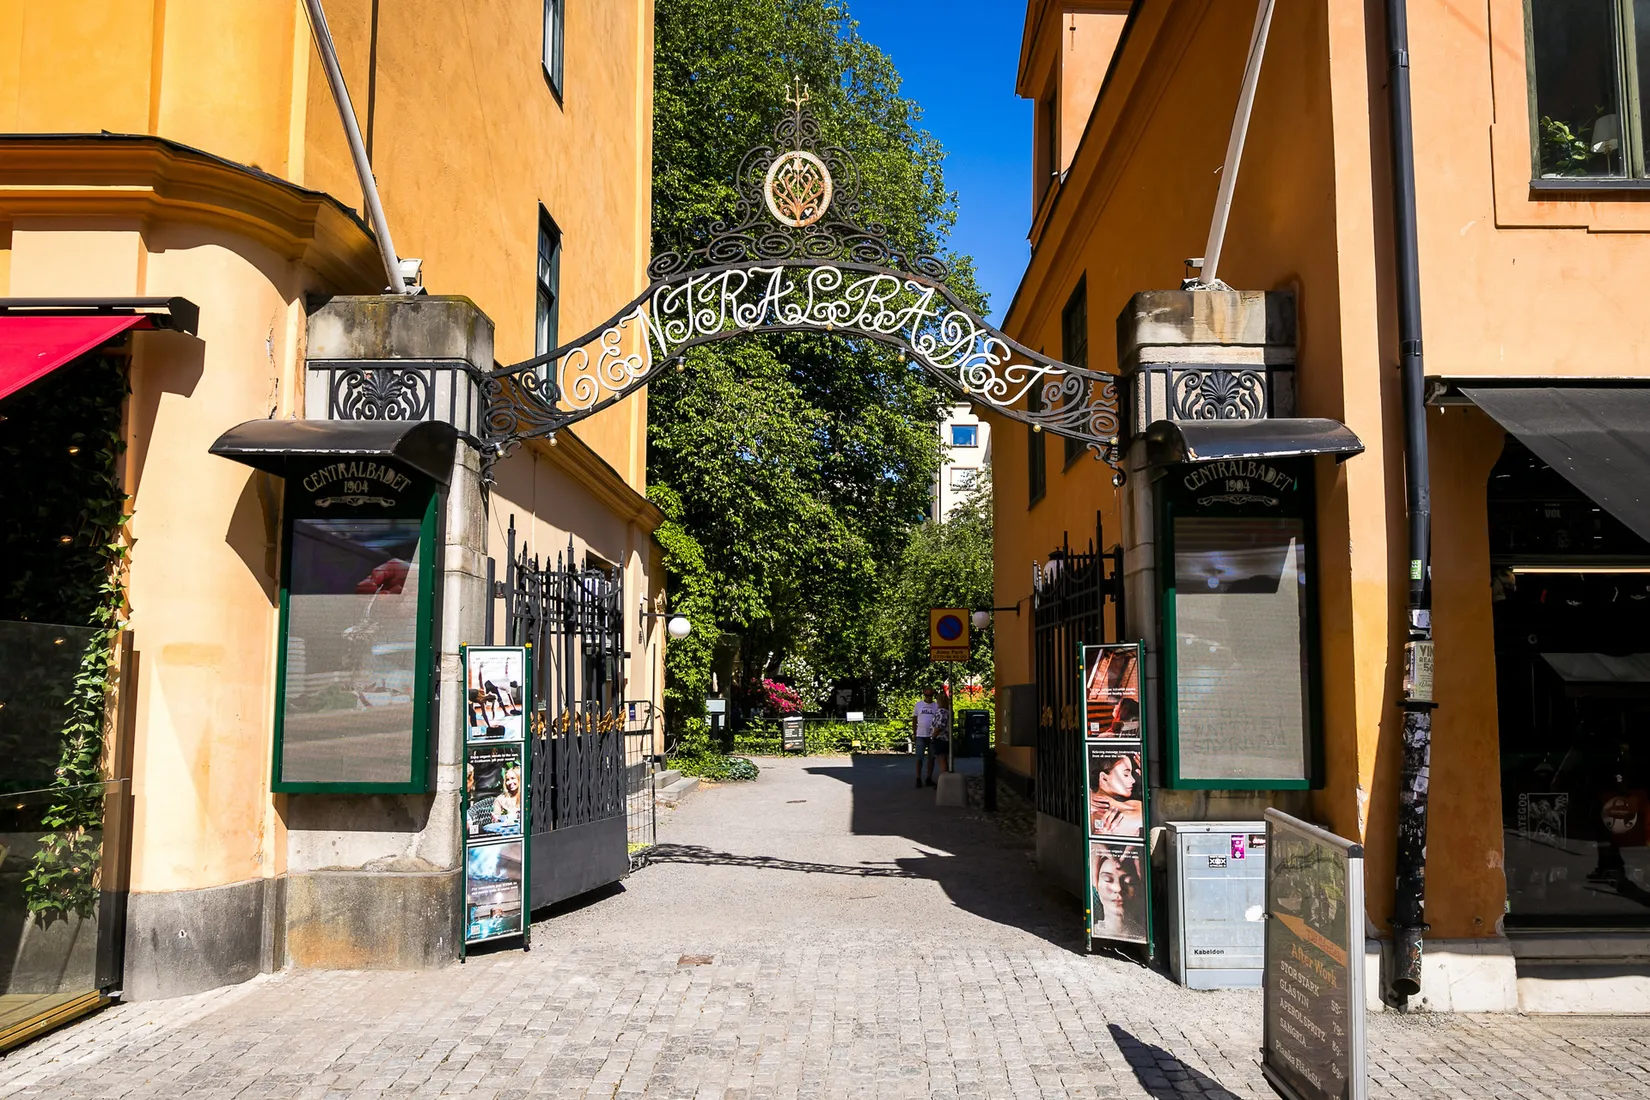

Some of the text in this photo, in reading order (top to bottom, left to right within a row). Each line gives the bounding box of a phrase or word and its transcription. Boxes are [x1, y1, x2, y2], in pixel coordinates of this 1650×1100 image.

[560, 265, 1067, 410] CENTRALBADET
[303, 461, 412, 492] CENTRALBADET
[344, 480, 368, 493] 1904
[1183, 460, 1293, 491] CENTRALBADET
[1225, 479, 1250, 492] 1904
[1291, 943, 1313, 969] After
[1314, 958, 1337, 988] Work
[1280, 1017, 1307, 1047] SANGRIA
